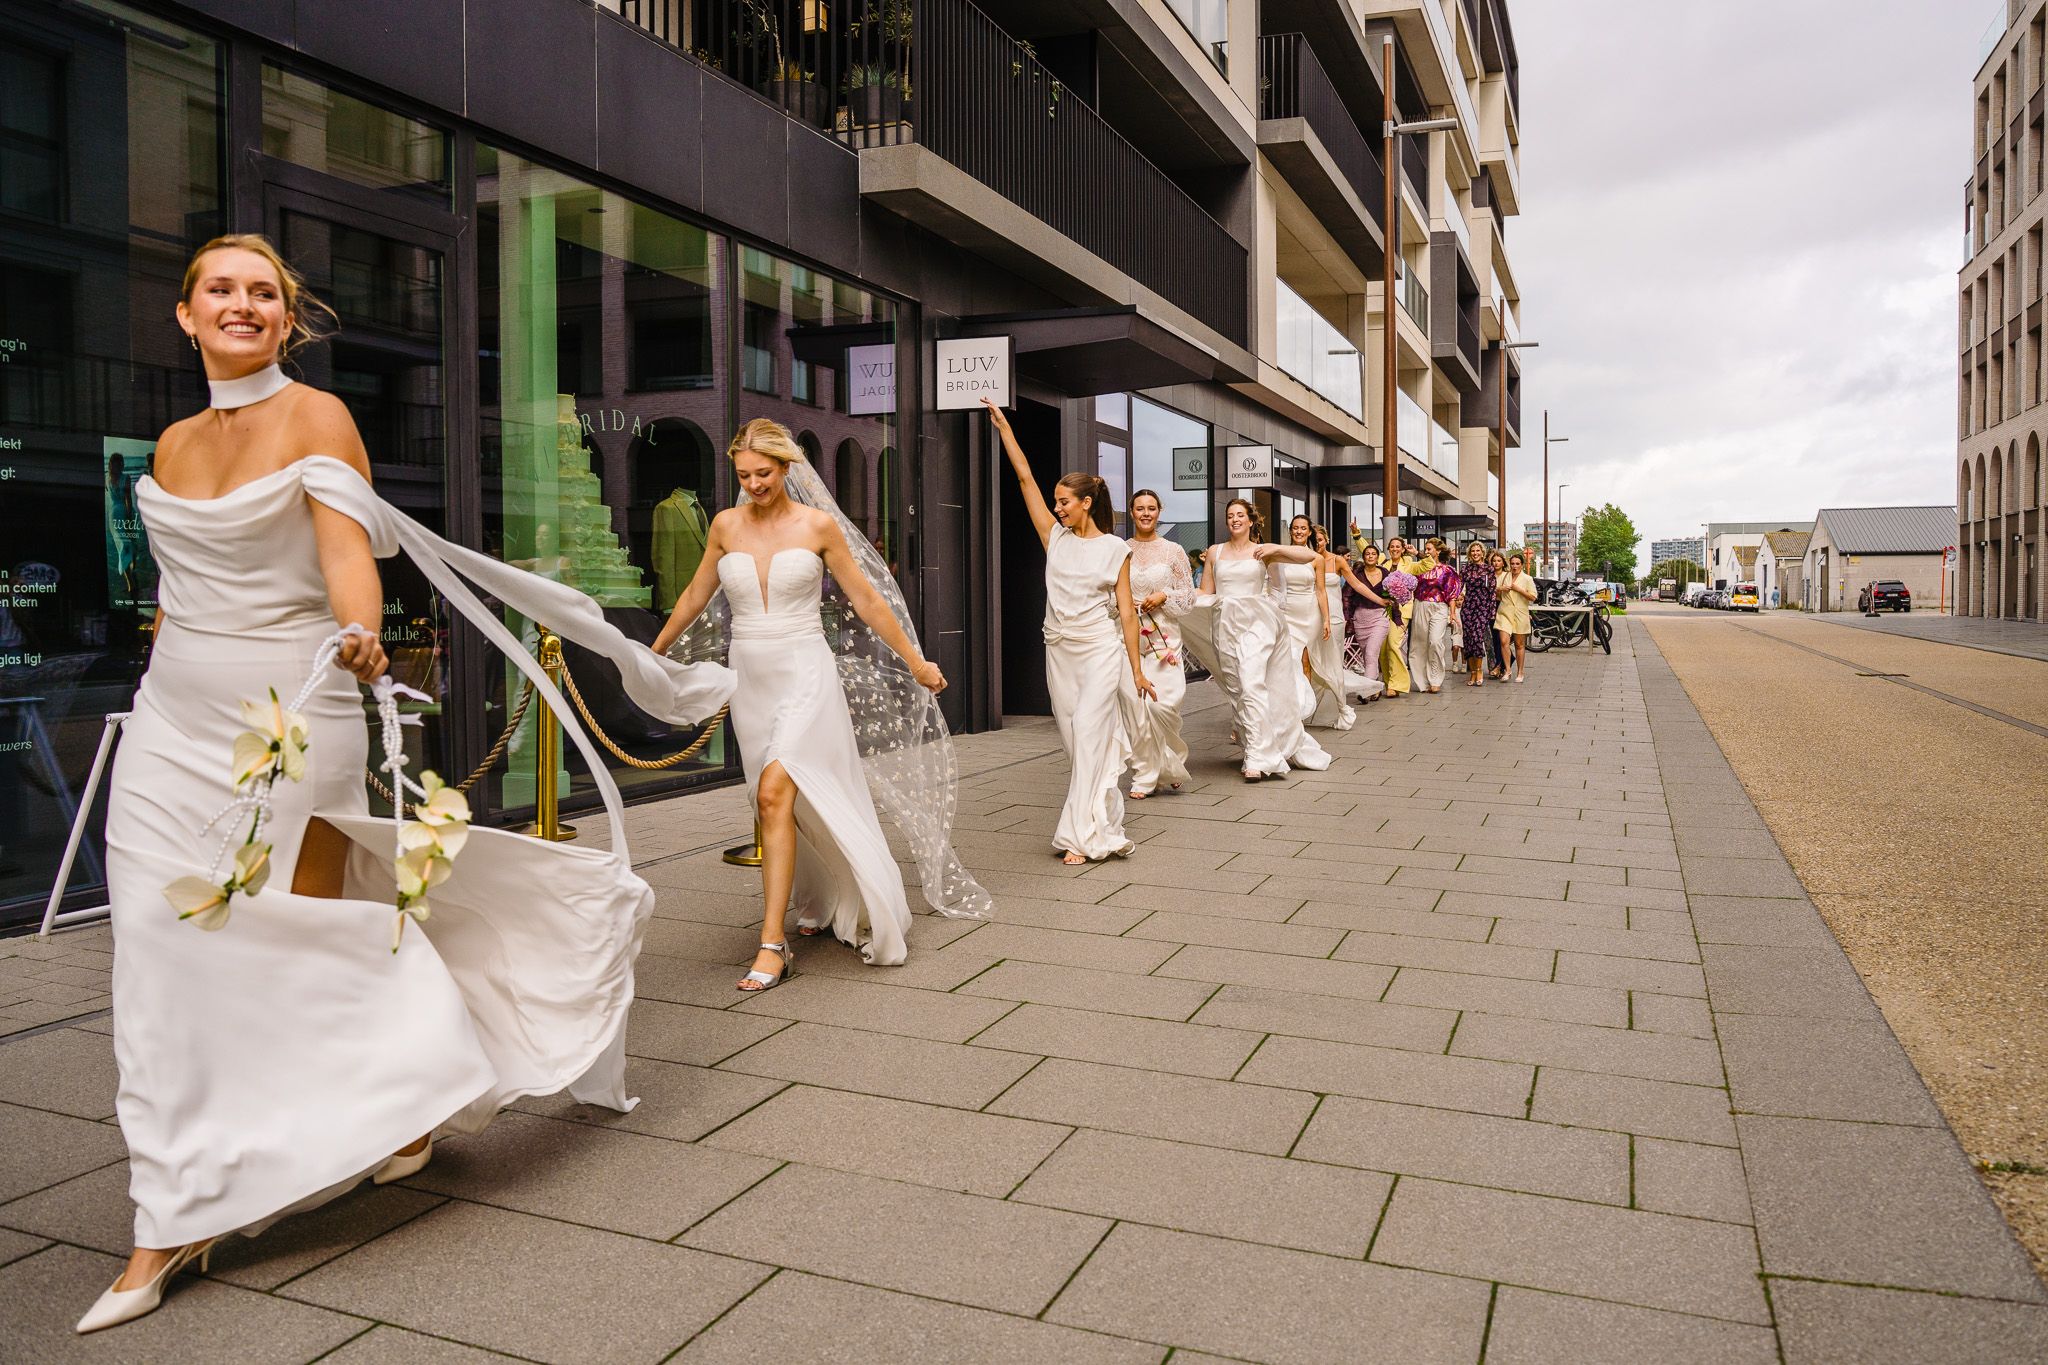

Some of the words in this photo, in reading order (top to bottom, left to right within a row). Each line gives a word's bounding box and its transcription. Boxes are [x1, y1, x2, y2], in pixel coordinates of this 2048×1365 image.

[946, 379, 999, 392] BRIDAL
[908, 504, 915, 515] 6
[12, 582, 57, 593] content
[12, 596, 38, 608] kern
[24, 652, 42, 666] ligt
